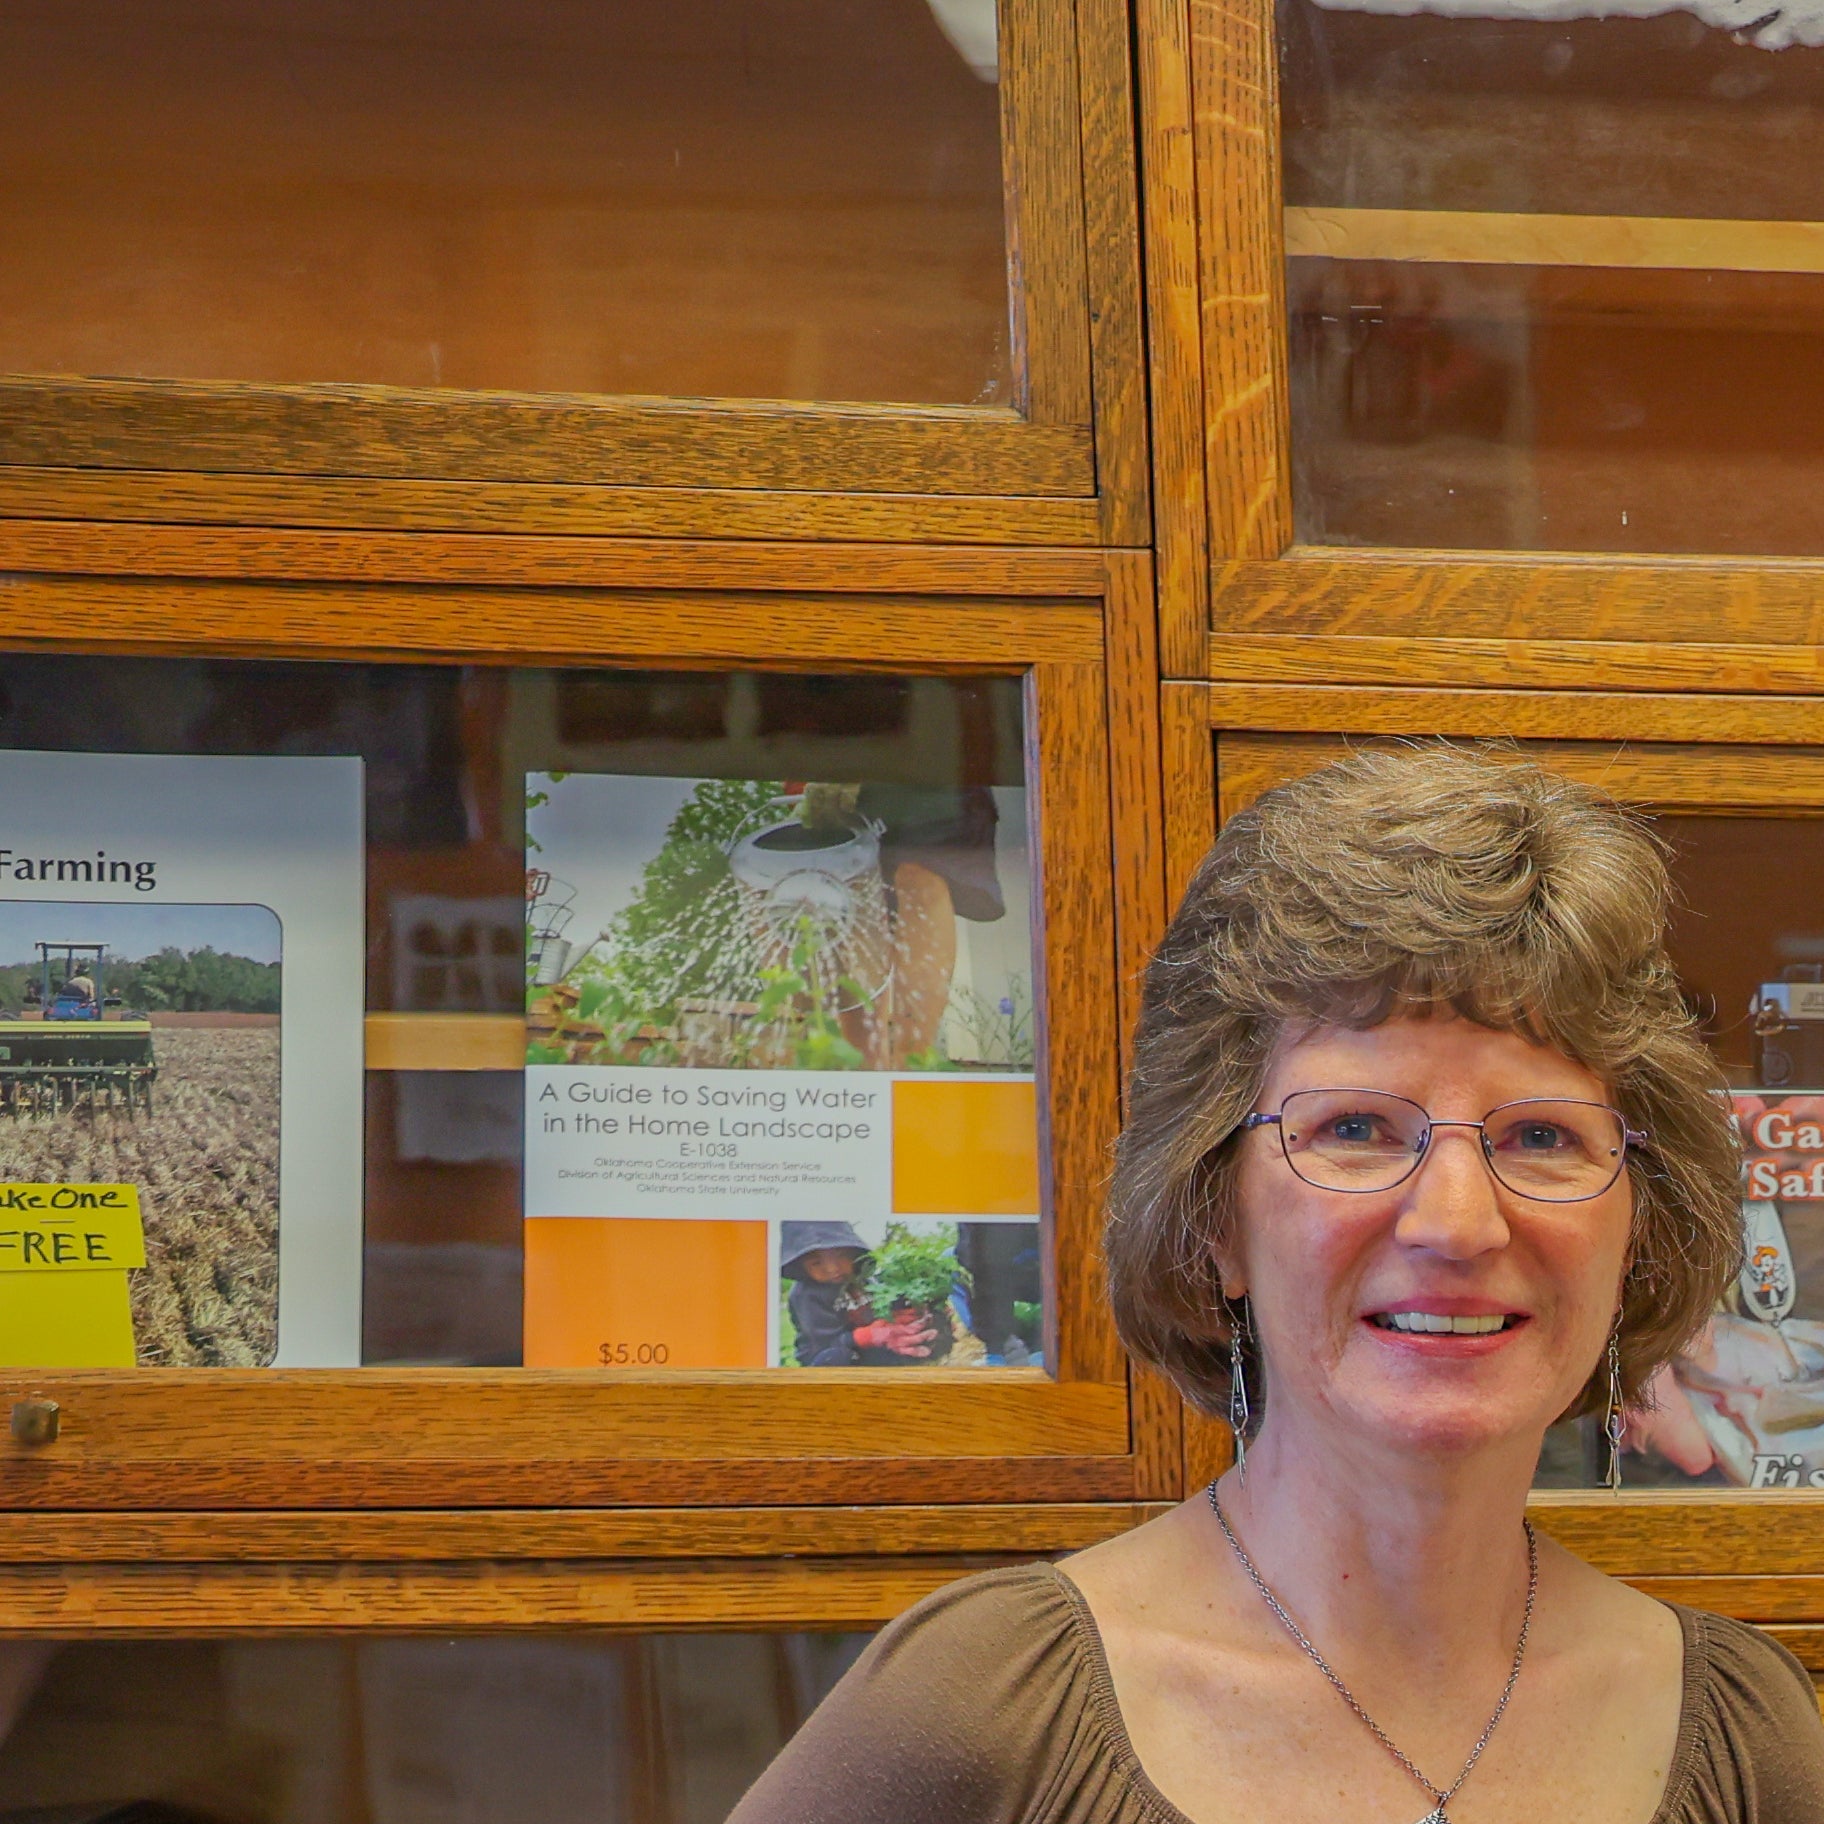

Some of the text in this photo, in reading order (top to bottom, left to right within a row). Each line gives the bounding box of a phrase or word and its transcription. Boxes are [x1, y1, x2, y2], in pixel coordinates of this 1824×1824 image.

[0, 849, 157, 892] Farming
[538, 1081, 877, 1112] A Guide to Saving Water
[543, 1112, 871, 1143] in the Home Landscape
[680, 1143, 738, 1158] E-1038
[51, 1188, 128, 1209] One
[598, 1343, 669, 1367] $5.00
